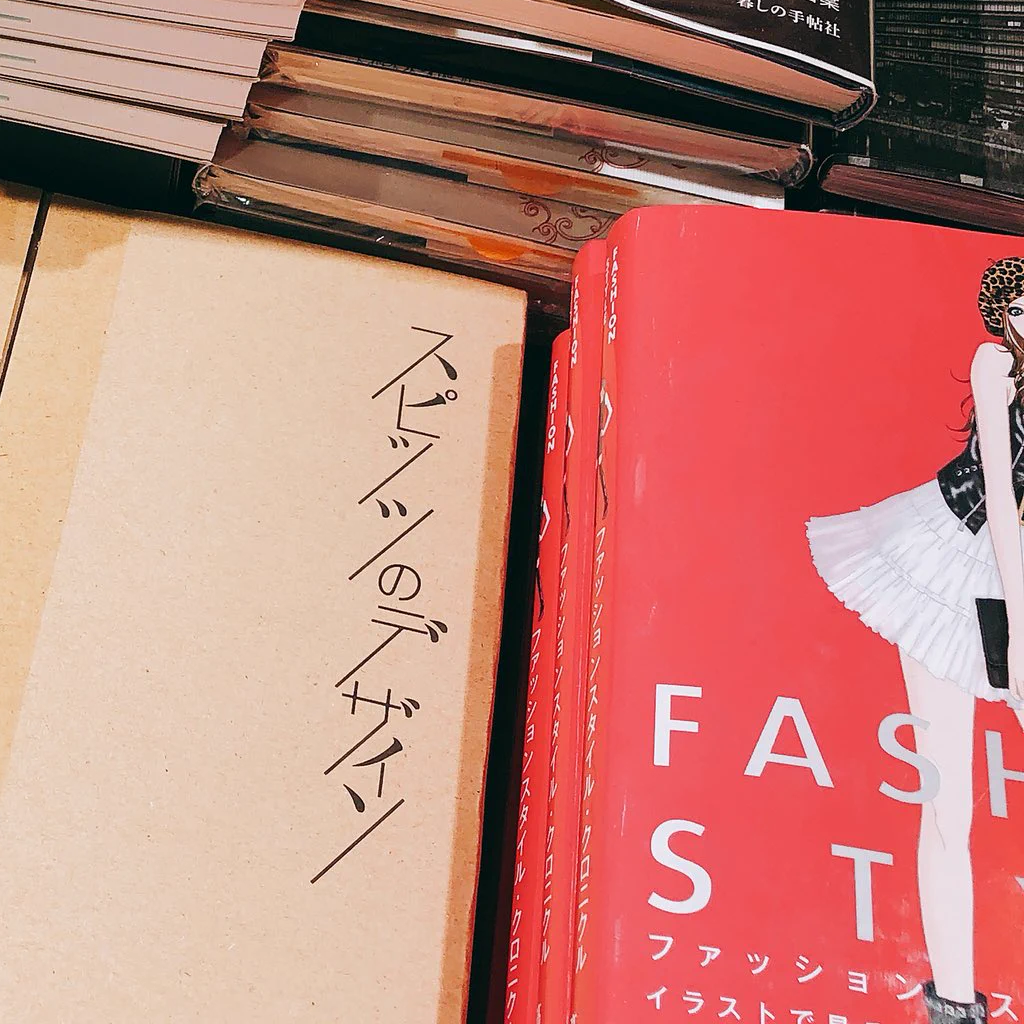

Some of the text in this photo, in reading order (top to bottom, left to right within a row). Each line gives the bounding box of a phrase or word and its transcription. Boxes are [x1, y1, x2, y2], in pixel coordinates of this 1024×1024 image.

[570, 274, 580, 369] FASHION
[607, 246, 619, 345] FASHION
[546, 359, 559, 454] FASHION
[310, 325, 458, 884] スピッツのデザイン
[646, 986, 882, 1024] イラストで
